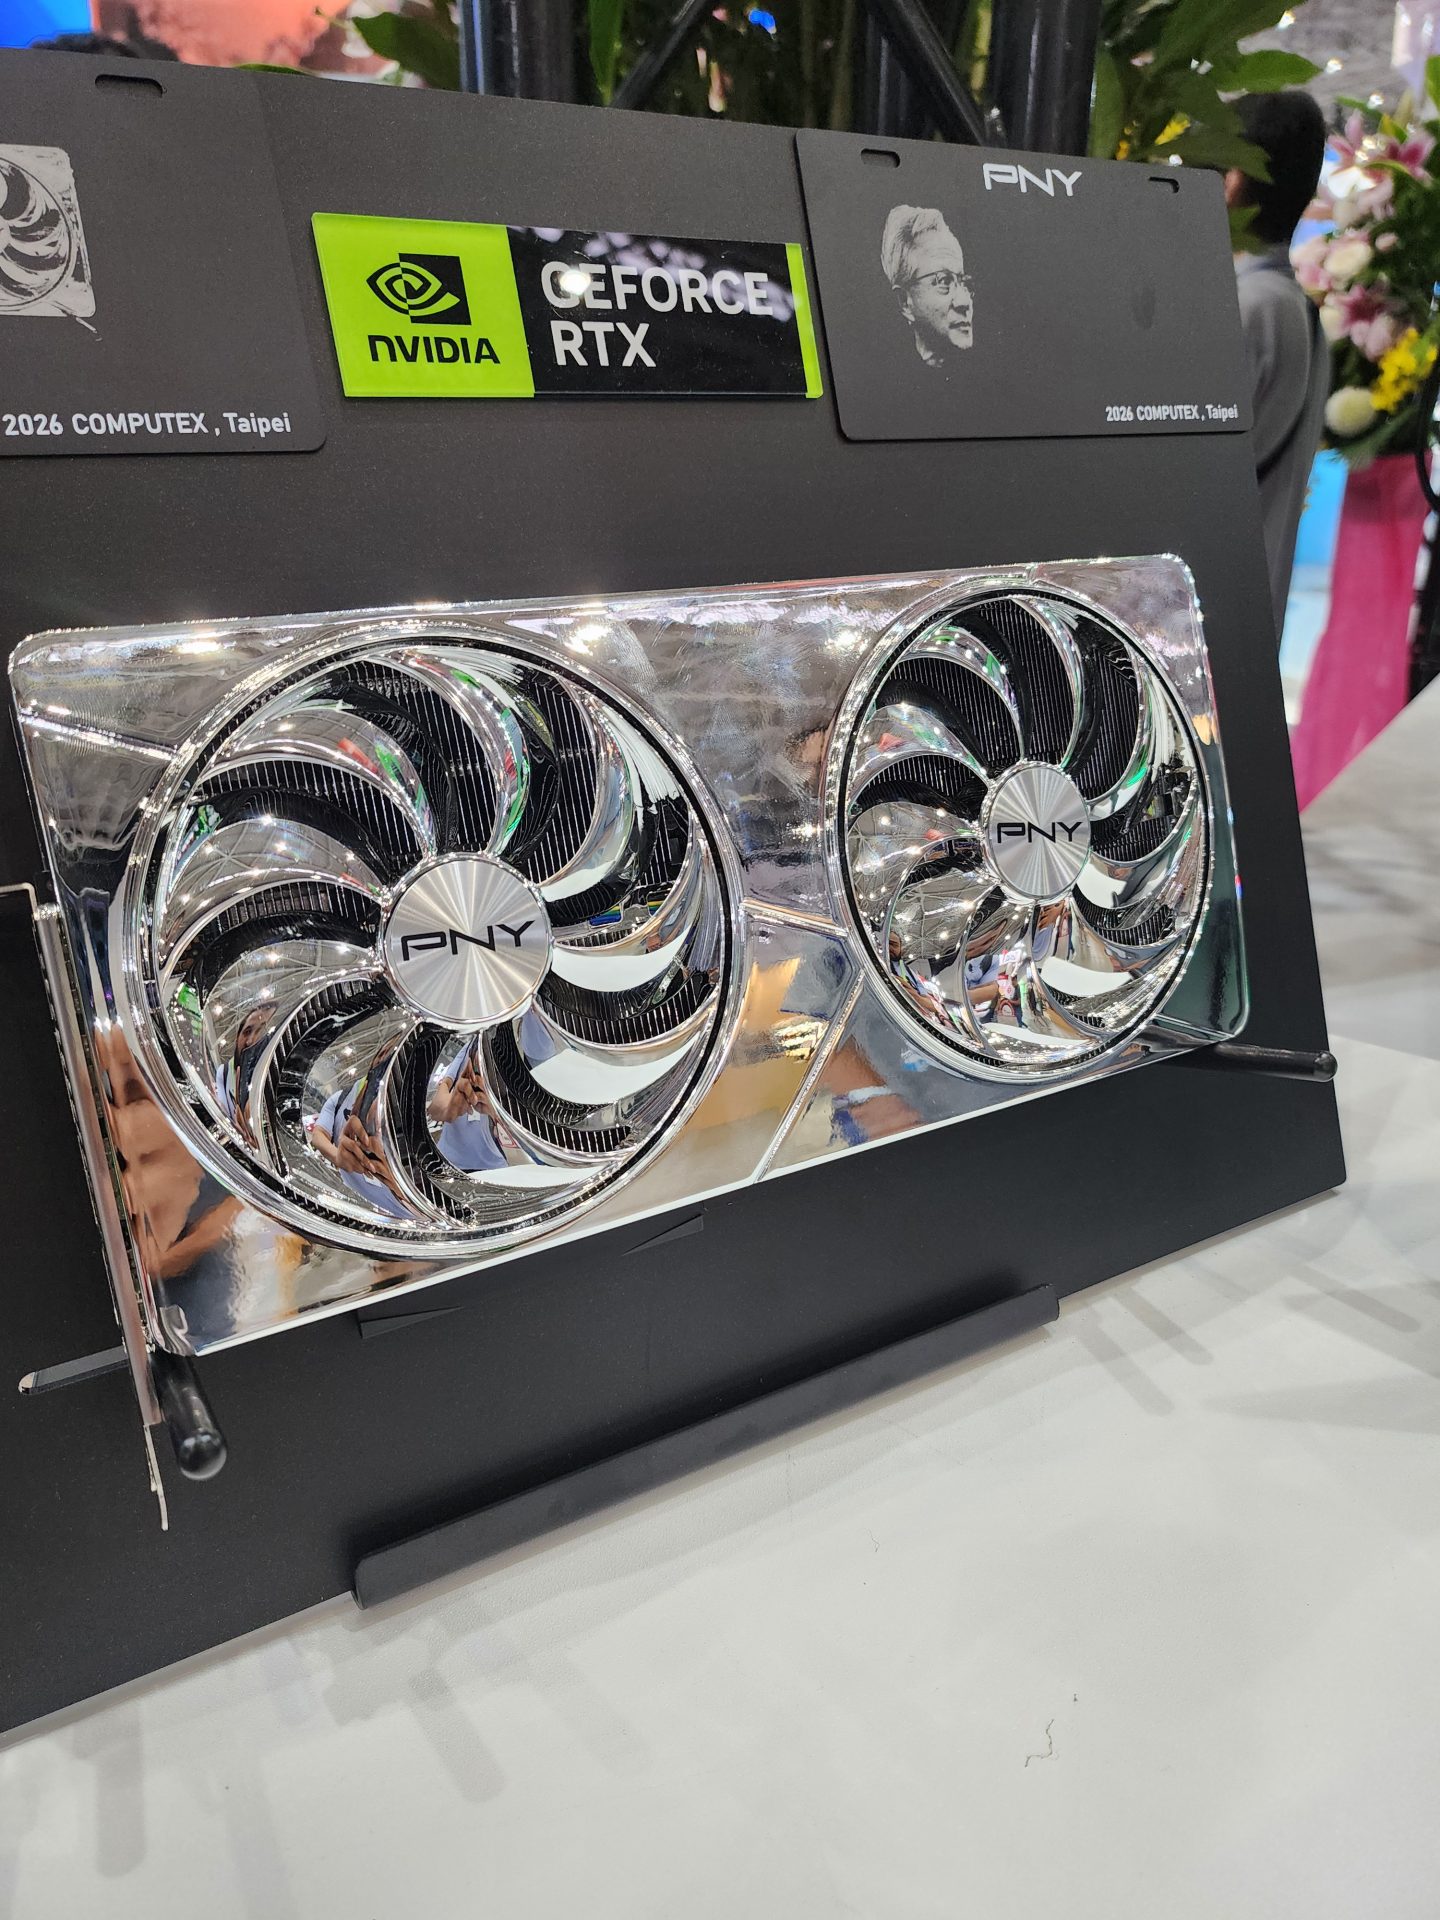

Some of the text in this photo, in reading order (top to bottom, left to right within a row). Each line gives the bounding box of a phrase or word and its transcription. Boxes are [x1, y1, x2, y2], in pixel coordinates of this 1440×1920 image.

[982, 162, 1083, 197] PNY
[540, 260, 774, 316] GEFORCE
[367, 334, 501, 365] NVIDIA
[550, 320, 657, 367] RTX
[1, 413, 63, 436] 2026
[1105, 405, 1135, 422] 2026
[996, 821, 1084, 844] PNY
[400, 919, 536, 962] PNY
